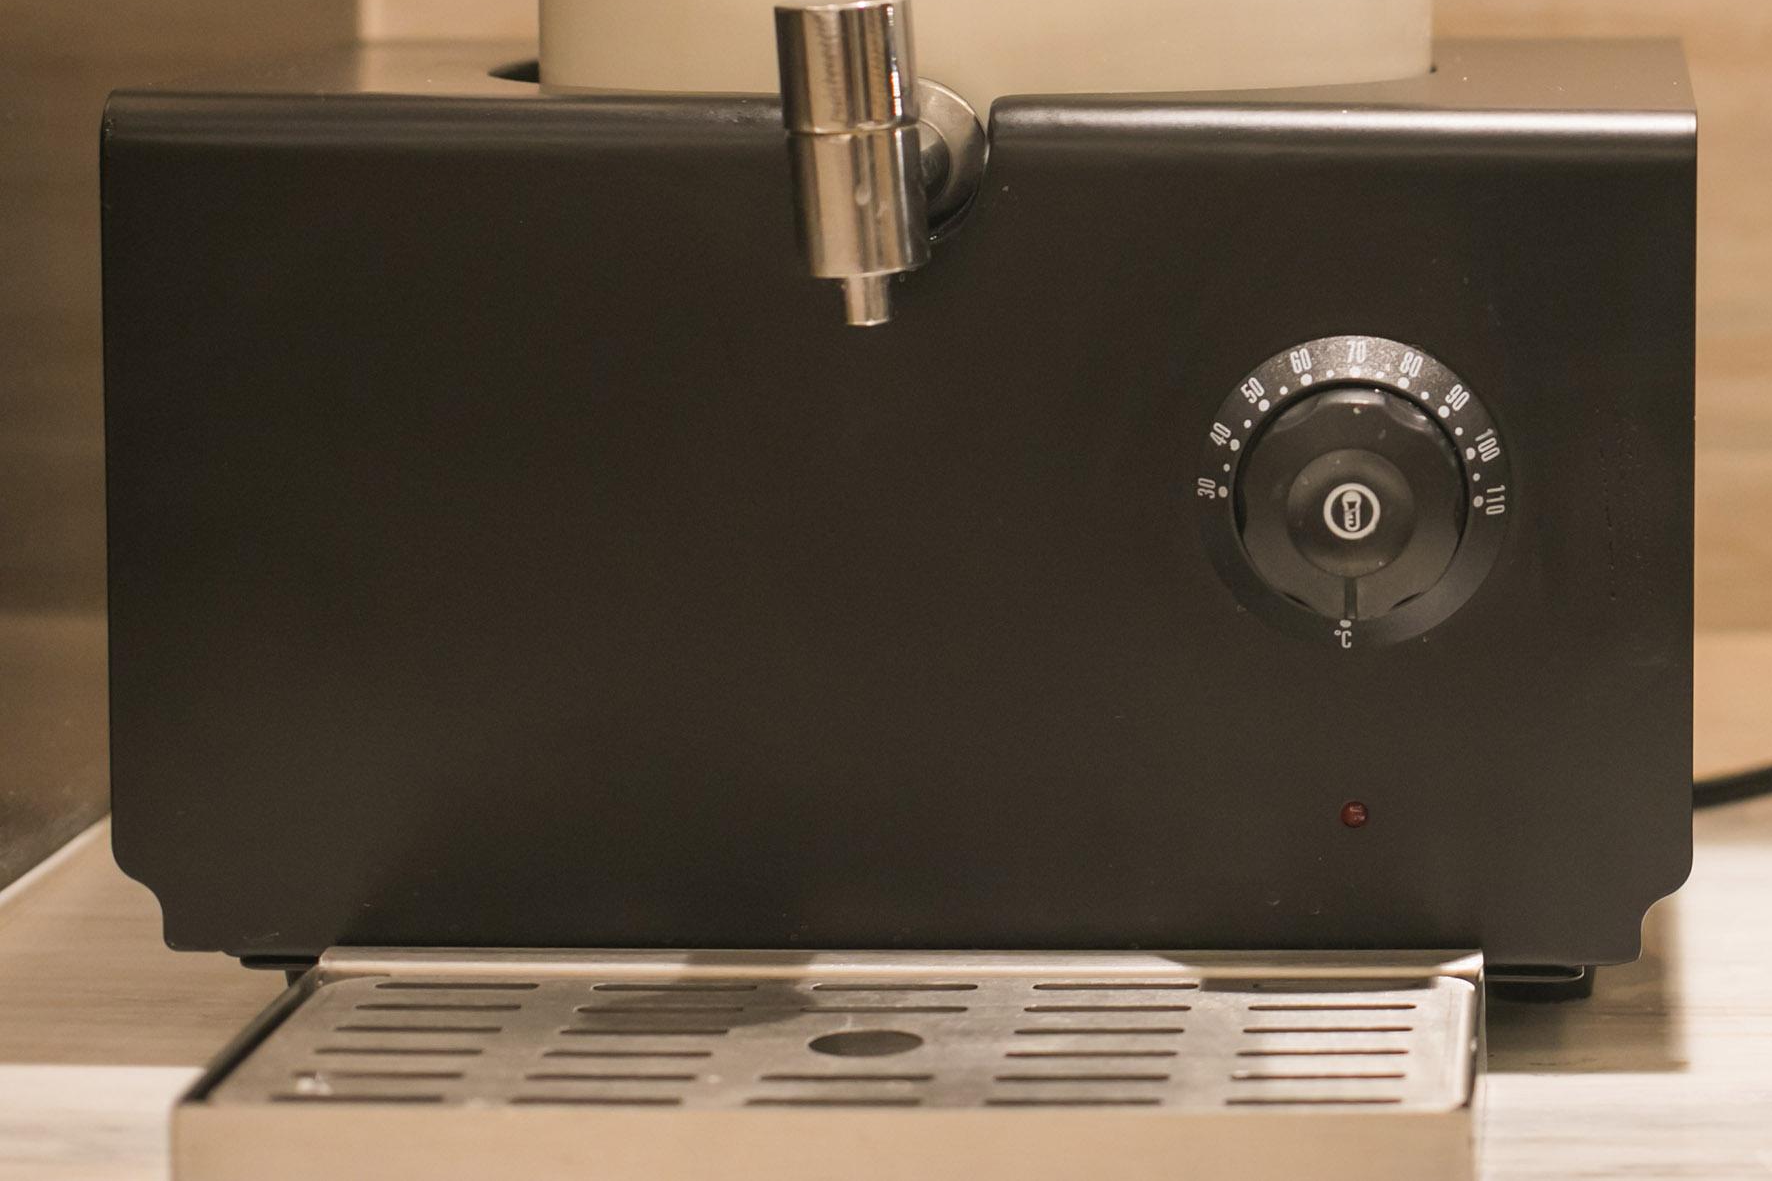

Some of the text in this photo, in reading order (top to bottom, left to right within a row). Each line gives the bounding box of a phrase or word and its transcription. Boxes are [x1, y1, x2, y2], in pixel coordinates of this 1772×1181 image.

[1197, 340, 1505, 515] 30 40 50 60 70 80 90 100 110
